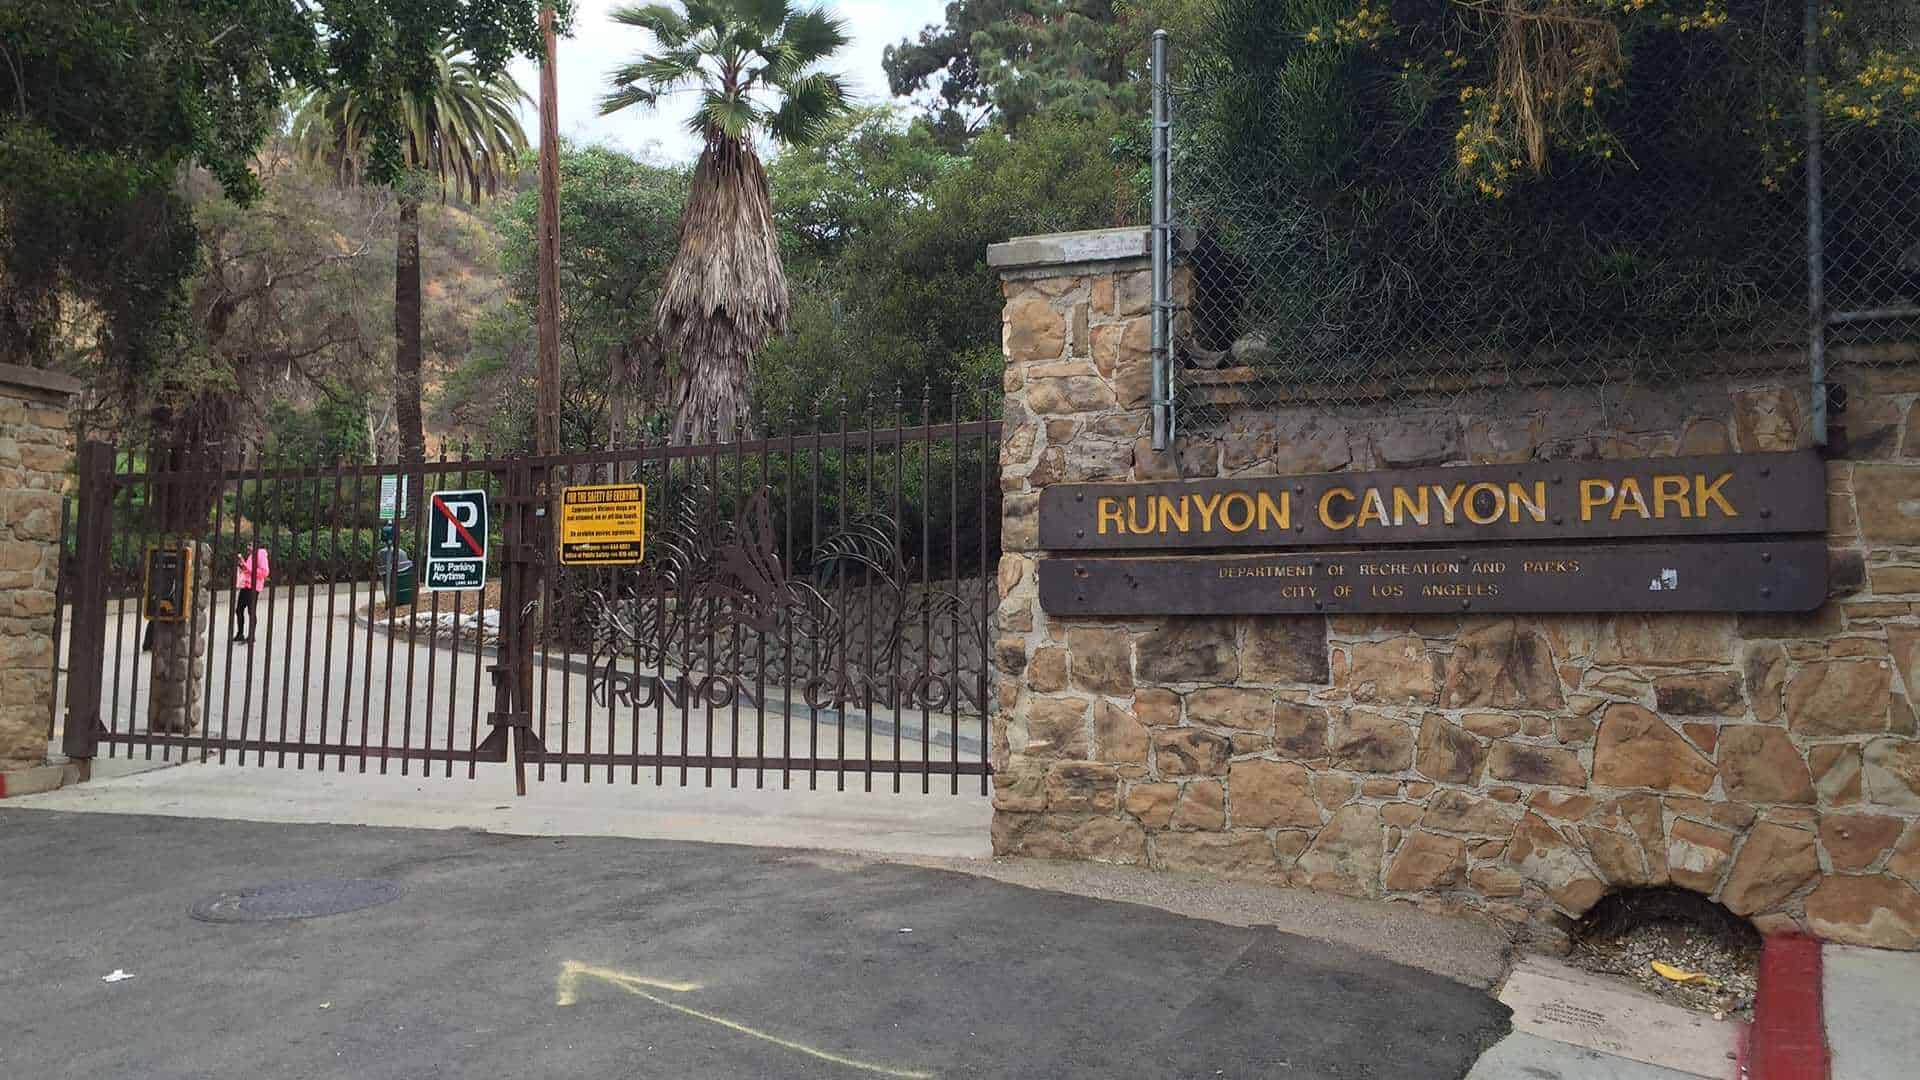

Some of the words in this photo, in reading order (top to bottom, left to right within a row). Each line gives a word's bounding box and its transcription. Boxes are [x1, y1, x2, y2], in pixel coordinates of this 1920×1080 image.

[1096, 489, 1290, 535] RUNYON
[1318, 480, 1547, 531] CANYON
[1579, 472, 1739, 522] PARK
[433, 562, 445, 572] No
[447, 562, 476, 573] Parking
[1218, 564, 1313, 579] DEPARTMENT
[1327, 564, 1345, 577] OF
[1359, 561, 1459, 577] RECREATION
[1471, 560, 1505, 575] AND
[1523, 559, 1581, 574] PARKS
[432, 571, 466, 583] Anytime
[1281, 585, 1319, 599] CITY
[1333, 584, 1353, 598] OF
[1372, 583, 1404, 598] LOS
[1421, 582, 1499, 597] ANGELES
[608, 675, 764, 710] RUNYON
[803, 673, 986, 712] CANYON
